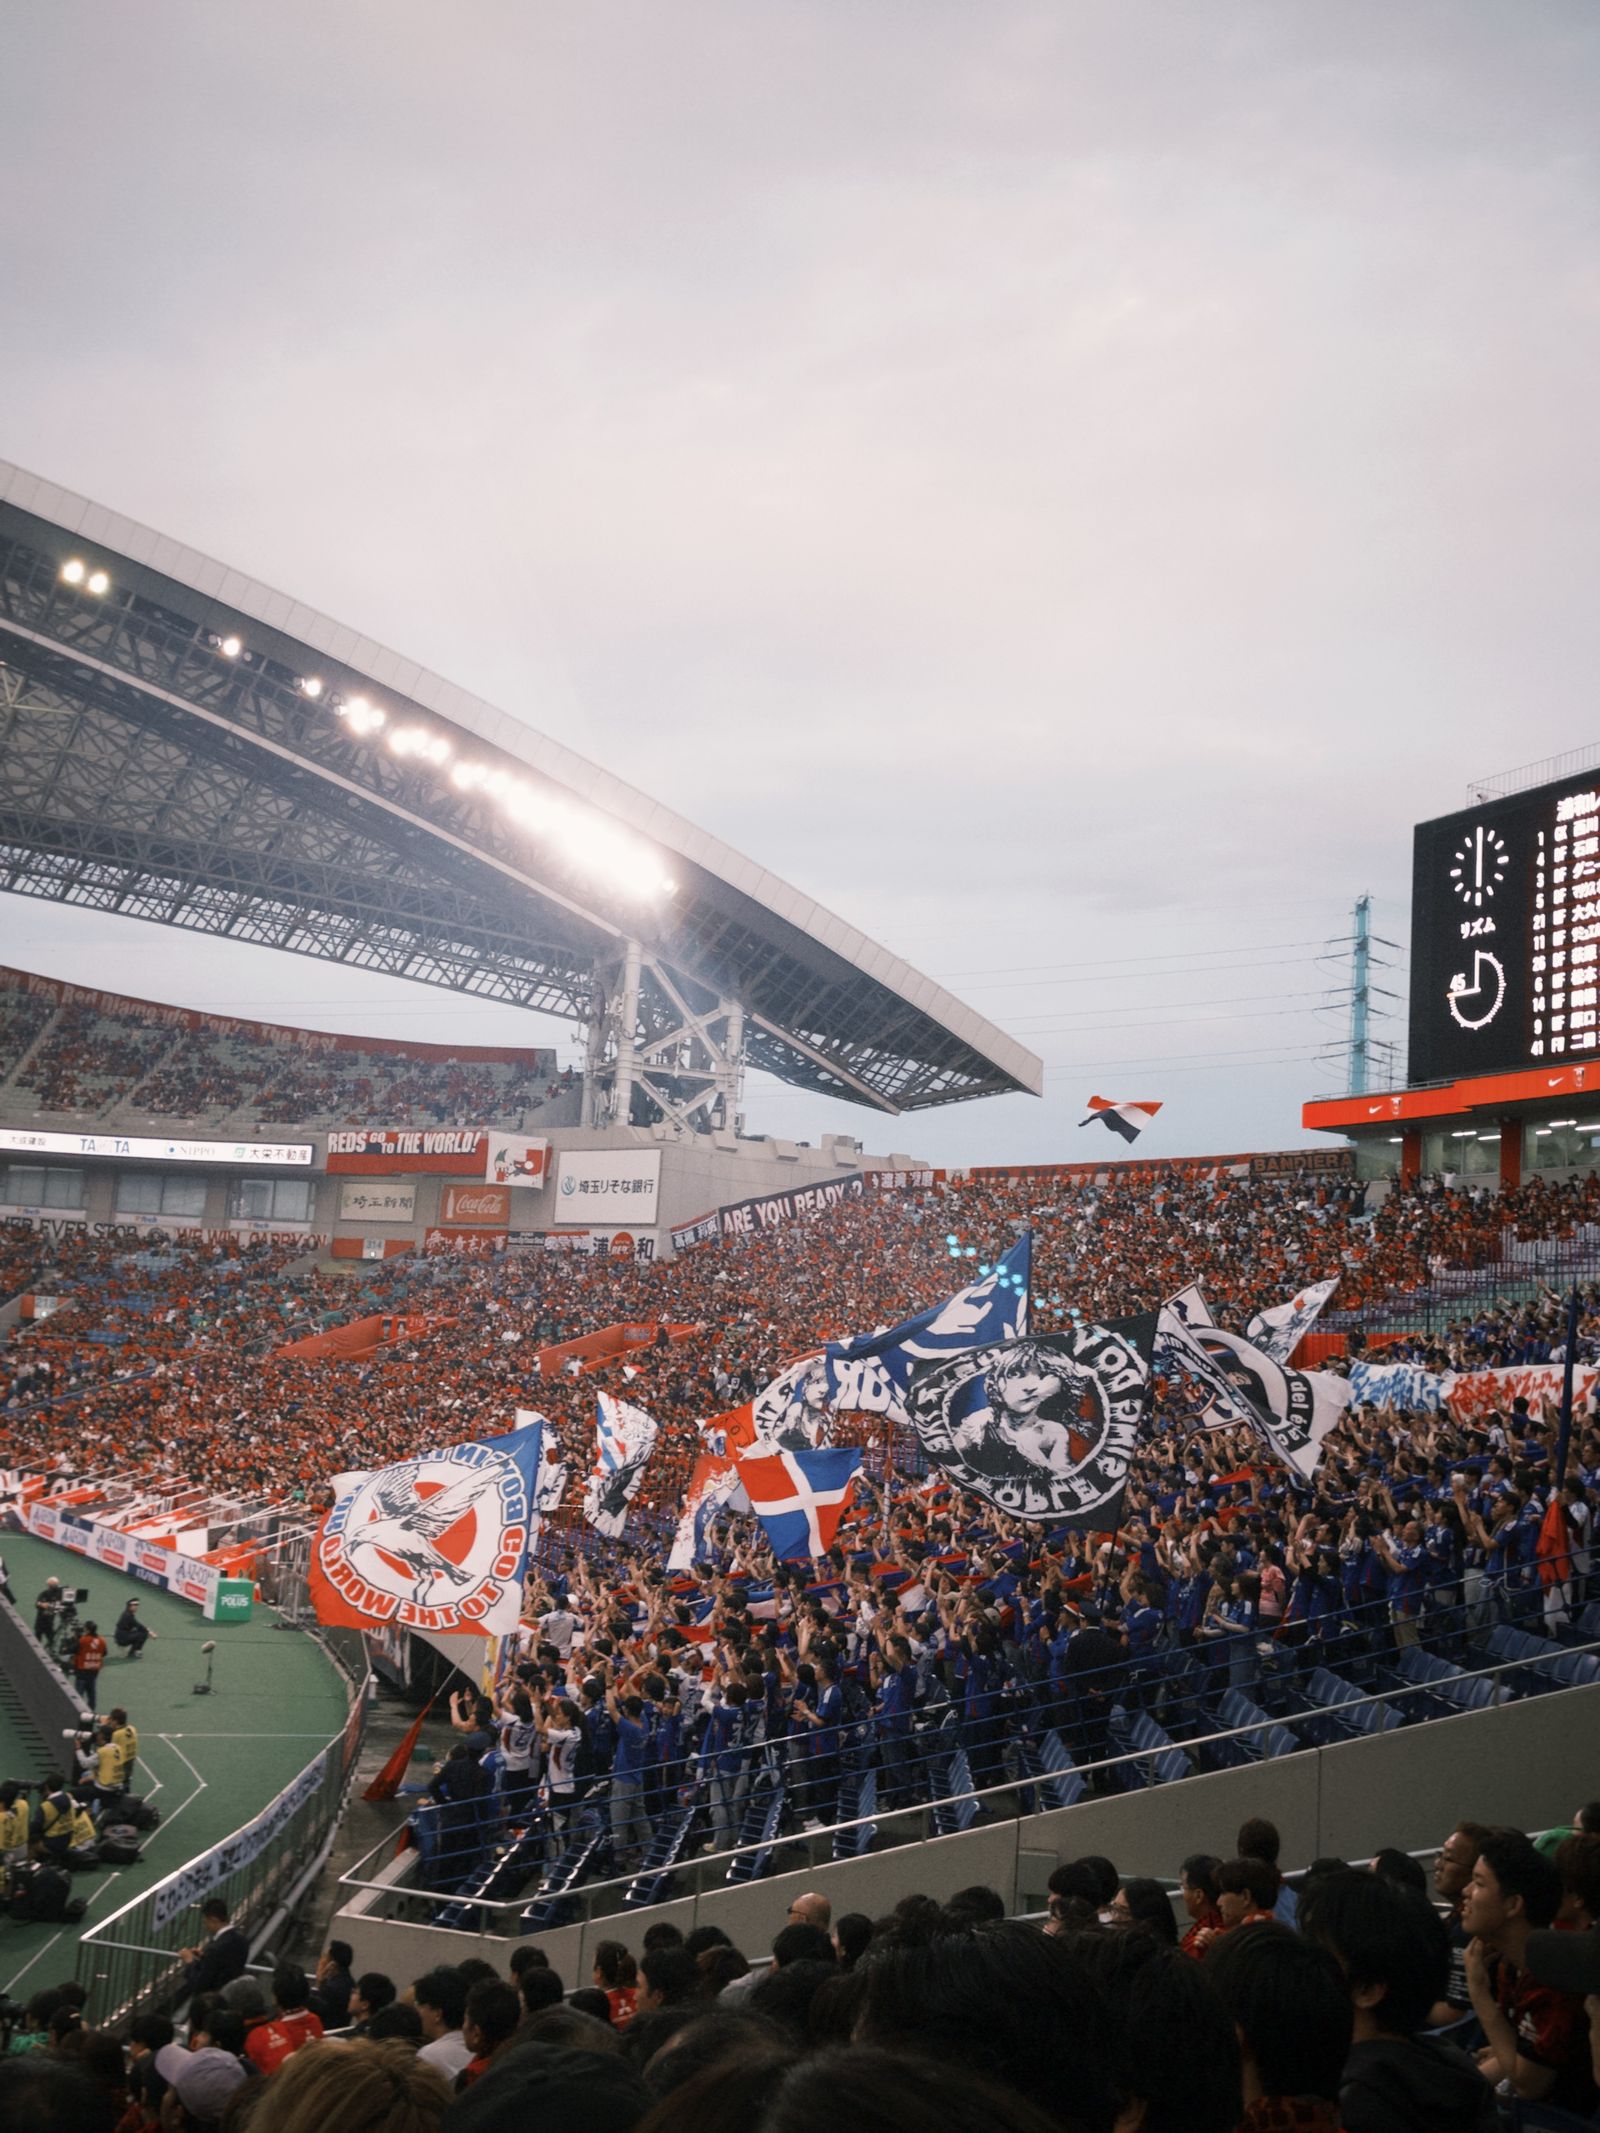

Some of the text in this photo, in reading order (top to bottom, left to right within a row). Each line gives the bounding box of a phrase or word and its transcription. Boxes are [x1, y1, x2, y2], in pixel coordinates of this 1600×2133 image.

[1460, 916, 1497, 940] リズム
[1449, 972, 1466, 991] 45
[328, 1132, 482, 1154] REDS GO TO THE WORLD!
[578, 1179, 654, 1194] 埼玉りそな銀行
[352, 1196, 413, 1209] 埼玉新聞
[724, 1205, 755, 1234] ARE
[755, 1197, 791, 1227] YOU
[794, 1183, 845, 1213] READY
[221, 1596, 249, 1607] POLUS
